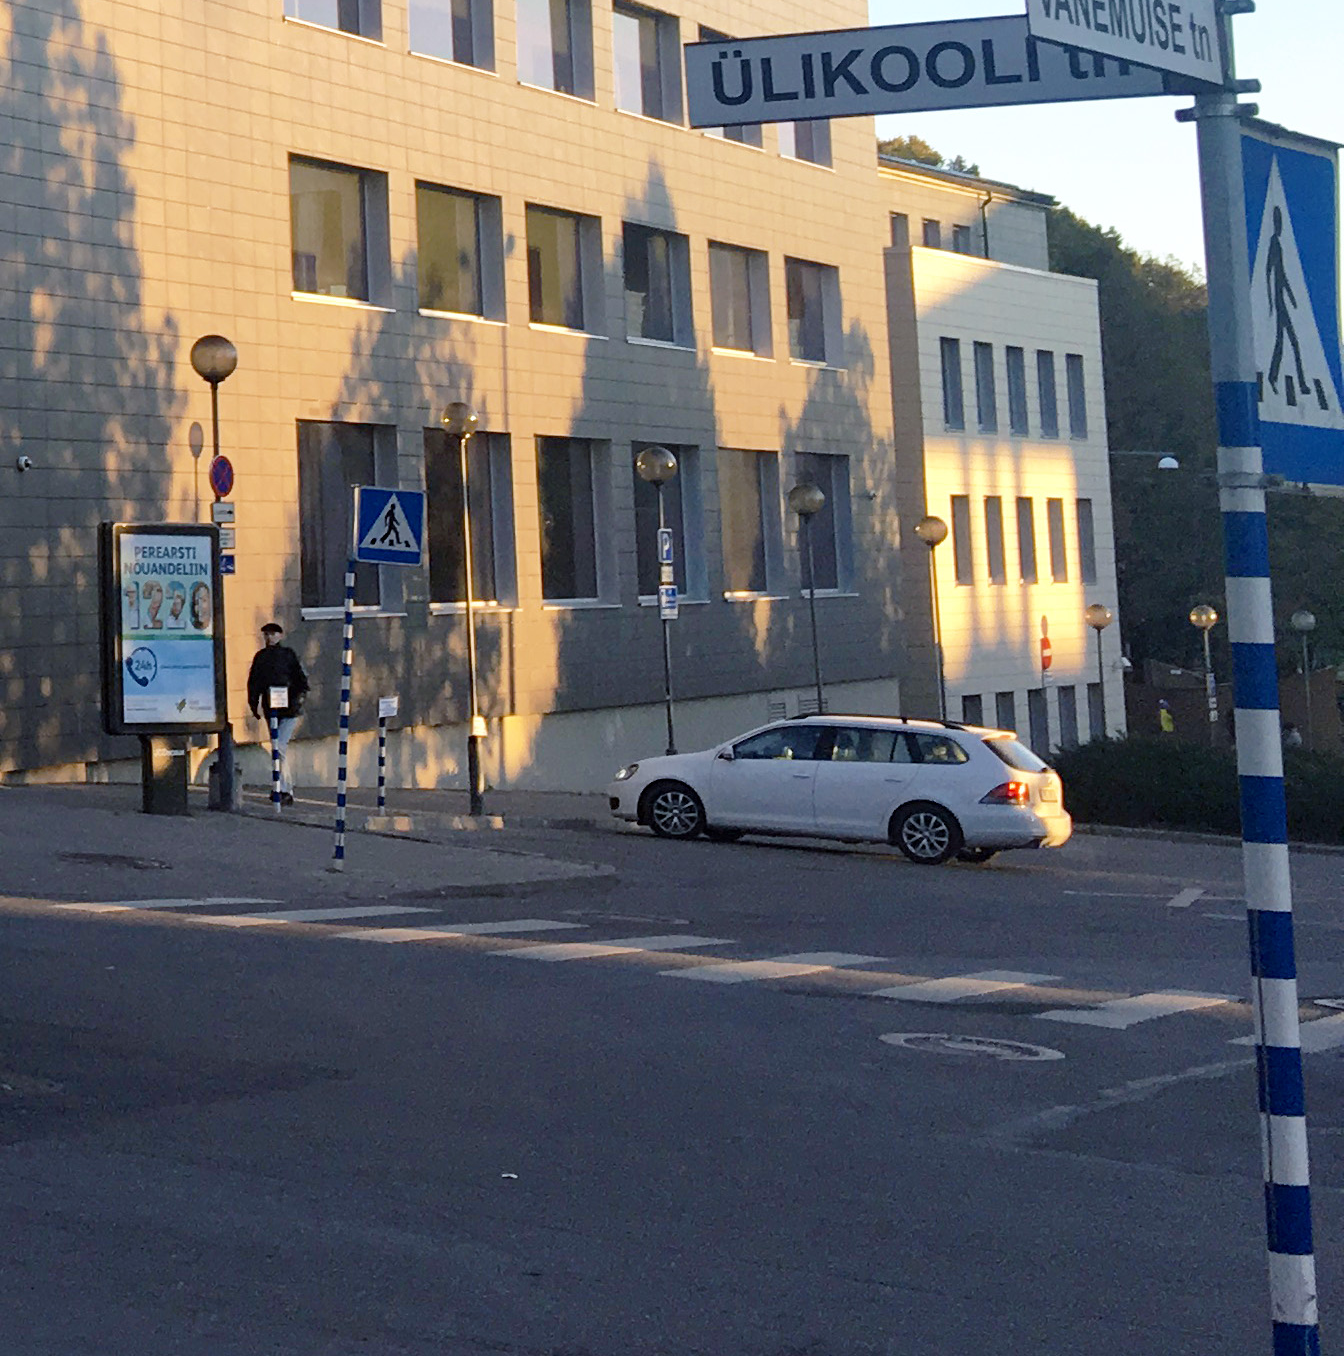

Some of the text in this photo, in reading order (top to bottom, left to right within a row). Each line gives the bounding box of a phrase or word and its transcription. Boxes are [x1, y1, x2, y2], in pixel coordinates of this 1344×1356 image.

[1189, 11, 1213, 63] tn
[711, 35, 1041, 106] ÜLIKOOLI
[134, 546, 197, 560] PEREARSTI
[123, 580, 211, 631] 1220
